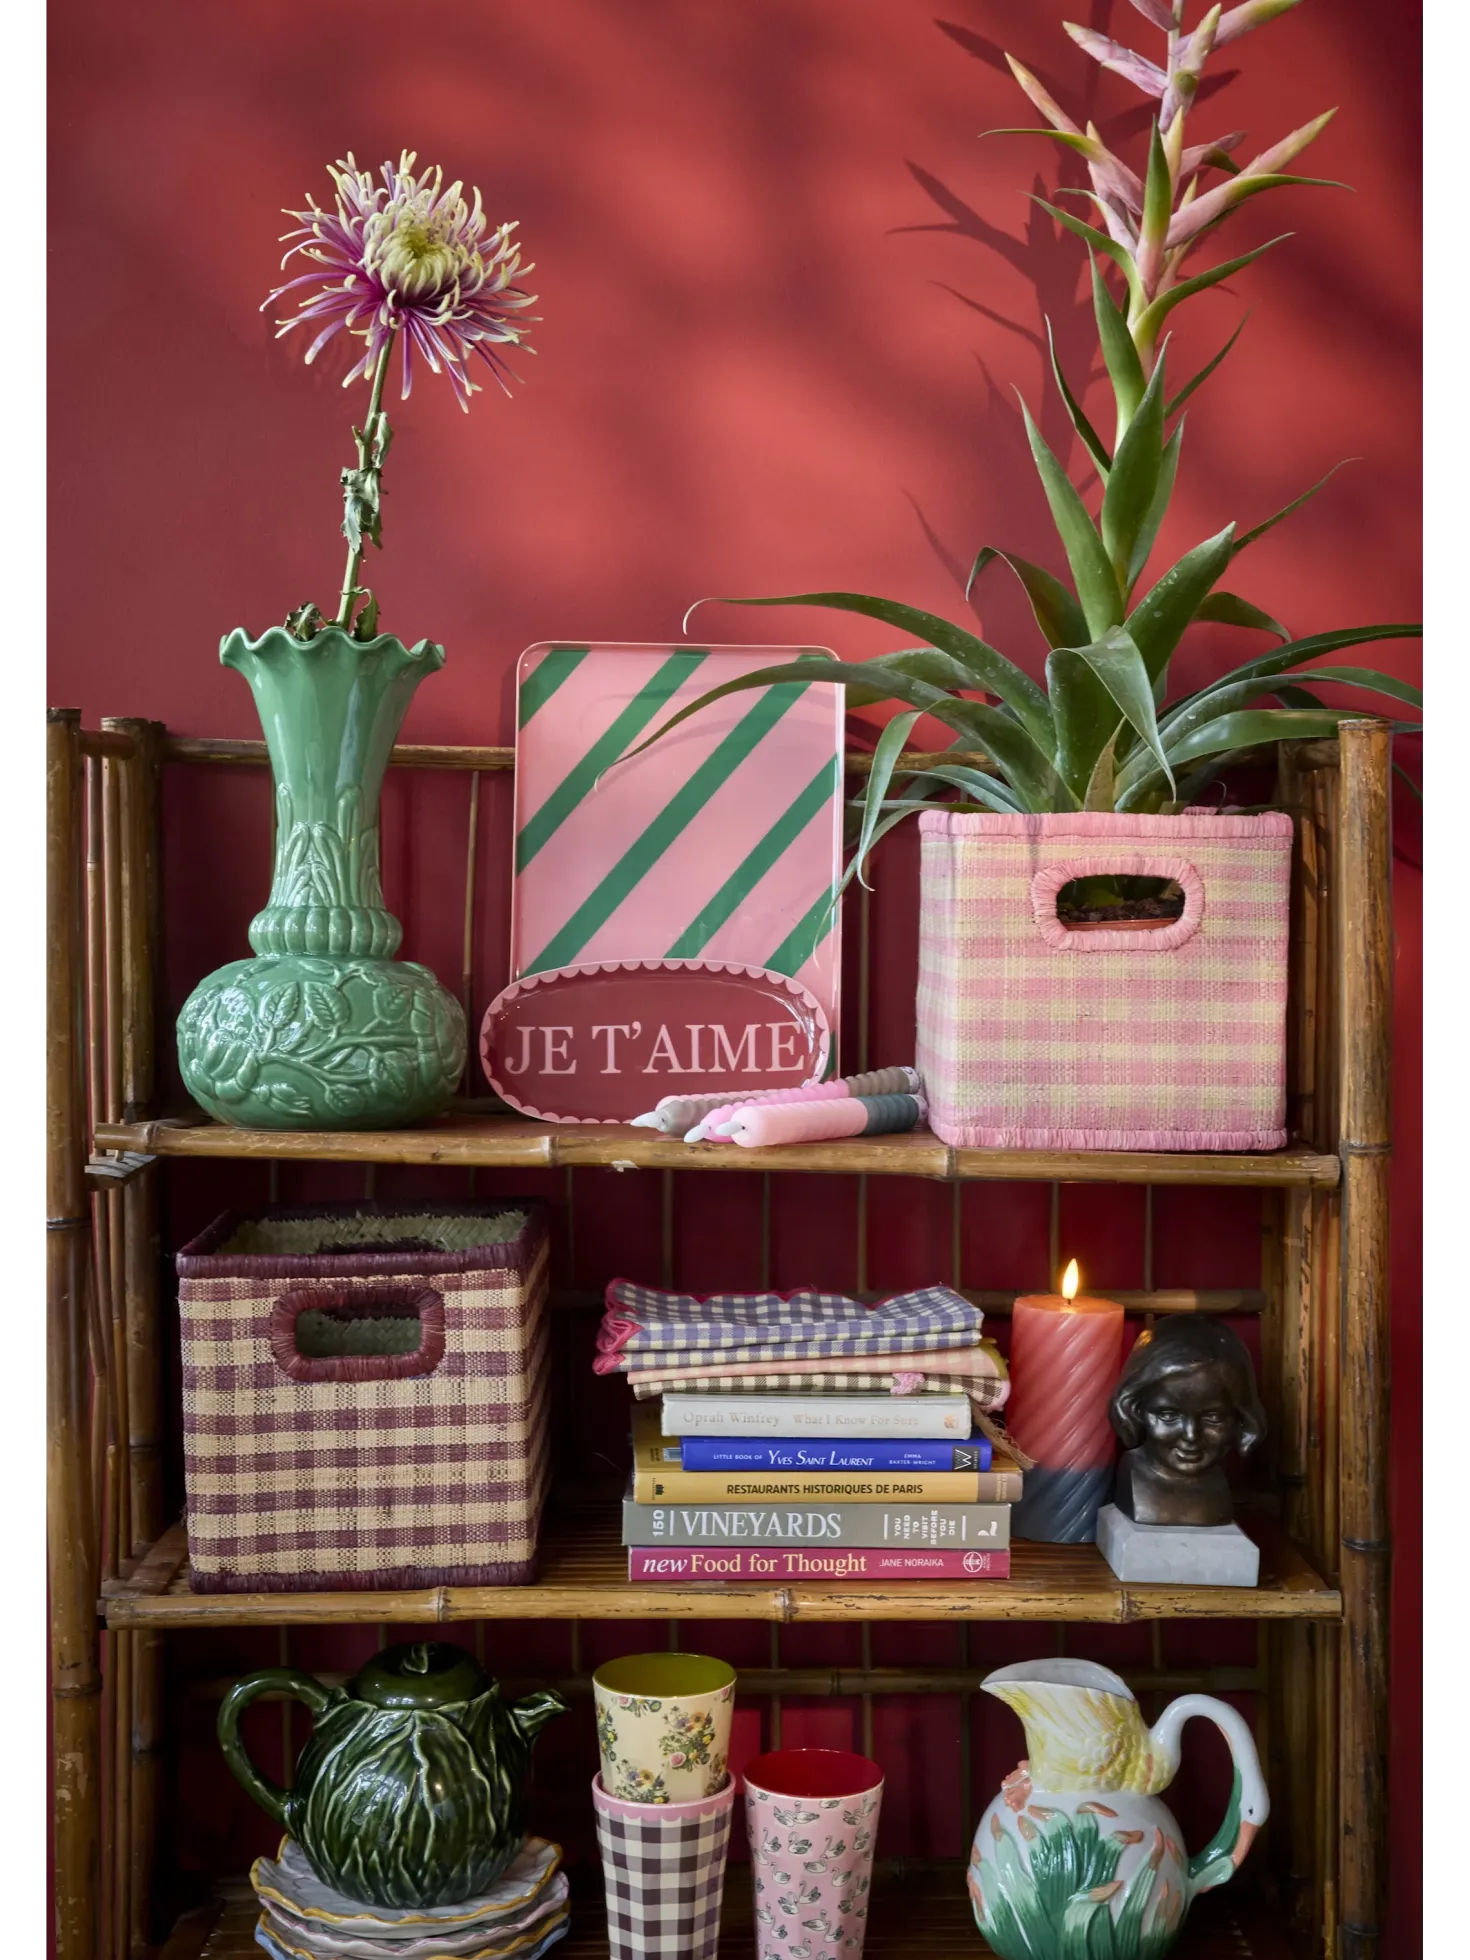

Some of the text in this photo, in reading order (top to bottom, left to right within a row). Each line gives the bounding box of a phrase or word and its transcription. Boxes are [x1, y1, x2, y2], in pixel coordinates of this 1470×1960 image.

[504, 1026, 578, 1075] JE
[683, 1411, 782, 1427] Oprah Winfrey
[792, 1413, 919, 1426] What I Know For Sure
[727, 1484, 923, 1495] RESTAURANTS HISTORIQUES DE PARIS
[652, 1509, 665, 1537] 150
[680, 1510, 842, 1538] VINEYARDS
[894, 1517, 902, 1536] YOU
[903, 1514, 911, 1539] NEED
[912, 1521, 919, 1534] TO
[921, 1515, 929, 1539] VISIT
[930, 1510, 938, 1545] BEFORE
[939, 1518, 947, 1537] YOU
[948, 1520, 956, 1536] DIE
[642, 1553, 867, 1577] new Food for Thought
[879, 1558, 944, 1567] JANE NORAIKA
